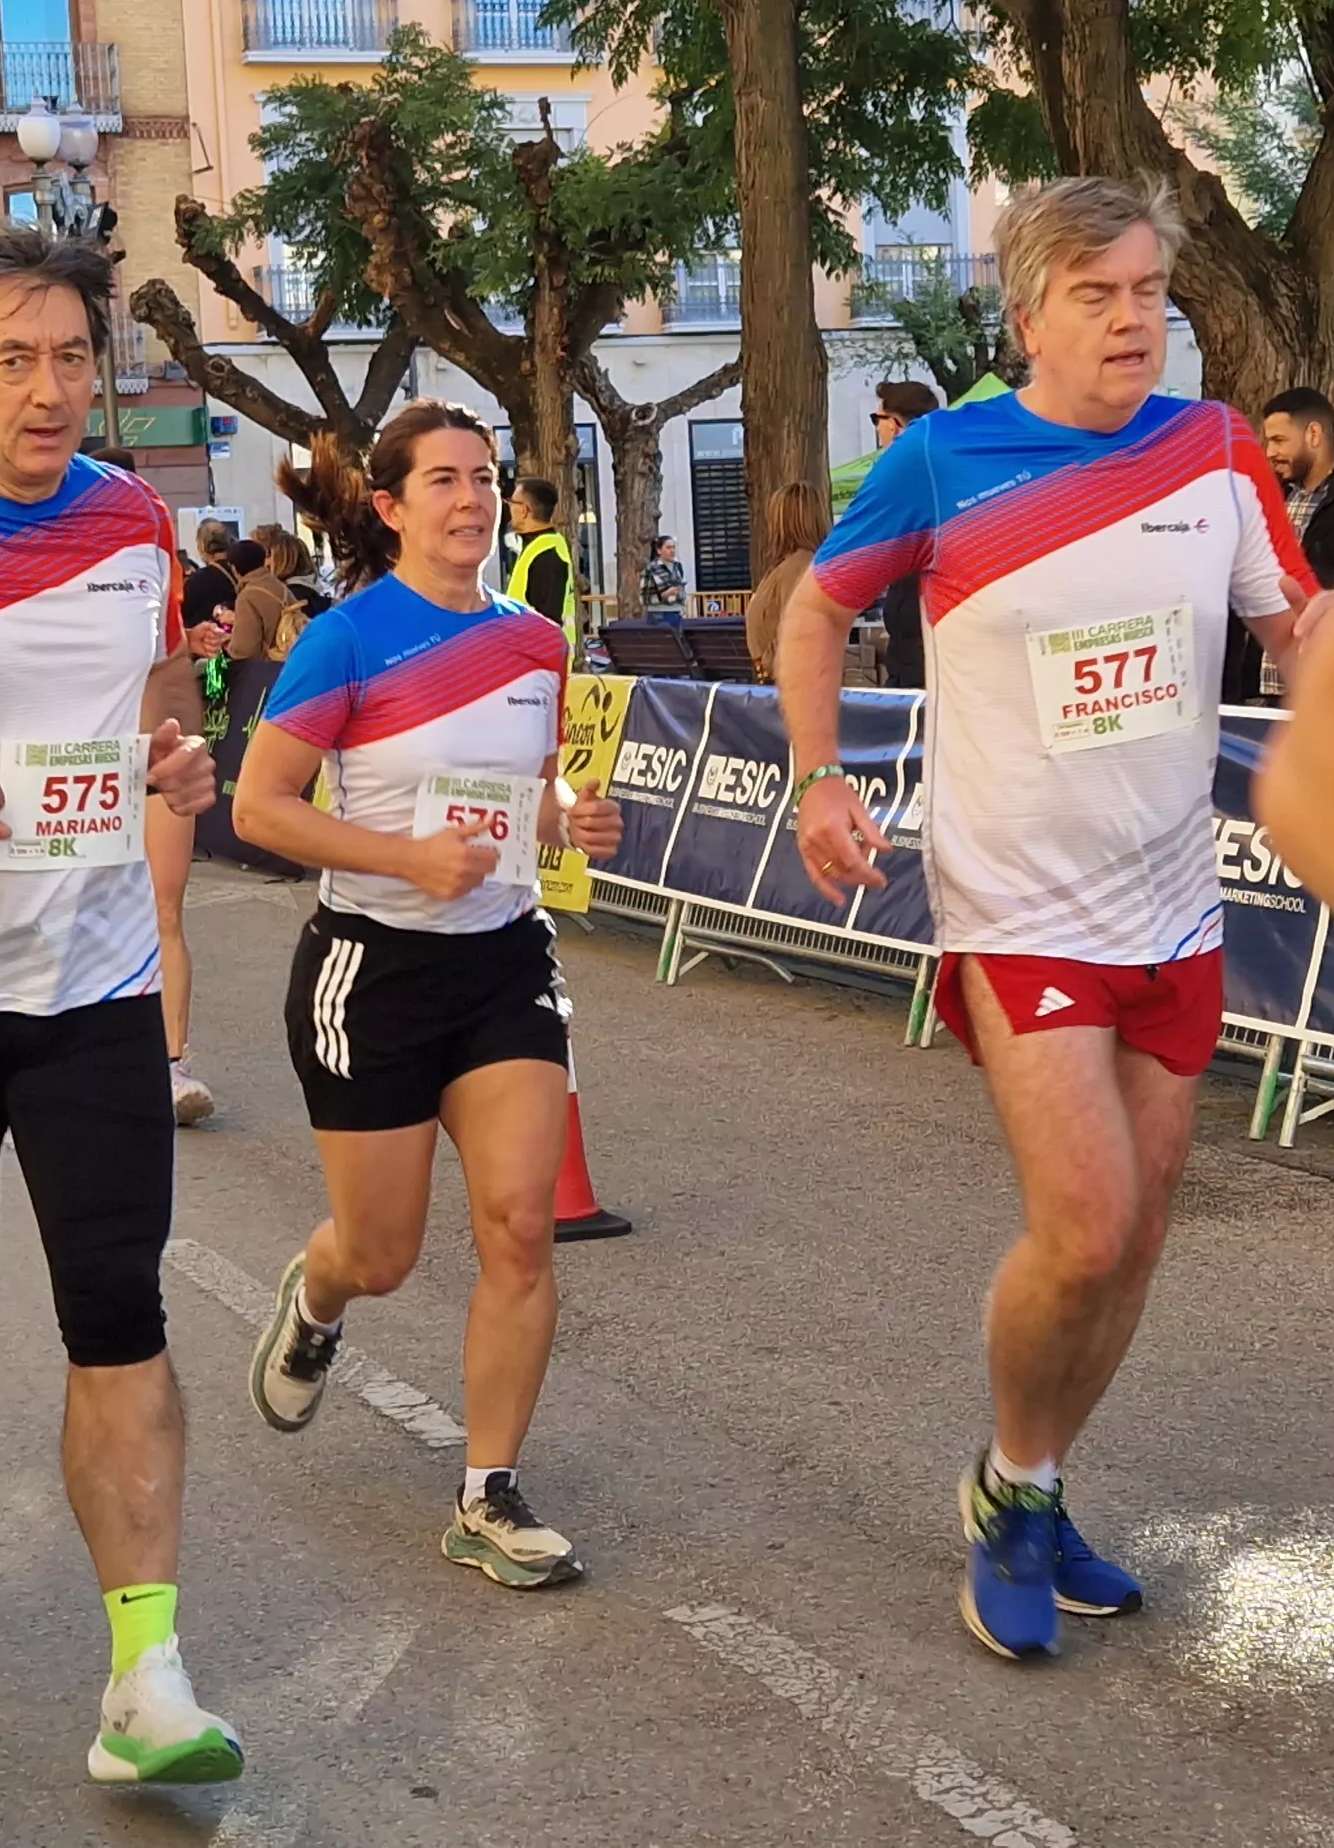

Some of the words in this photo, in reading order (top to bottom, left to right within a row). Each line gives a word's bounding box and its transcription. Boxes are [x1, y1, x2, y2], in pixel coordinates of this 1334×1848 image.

[1071, 628, 1085, 640] III
[1087, 615, 1155, 638] CARRERA
[1073, 644, 1159, 695] 577
[1061, 683, 1179, 720] FRANCISCO
[1092, 713, 1124, 735] 8K
[50, 744, 63, 755] III
[64, 740, 121, 755] CARRERA
[630, 743, 687, 793] ESIC
[41, 772, 121, 814] 575
[463, 778, 512, 794] CARRERA
[717, 757, 781, 809] ESIC
[35, 816, 123, 837] MARIANO
[48, 837, 78, 857] 8K
